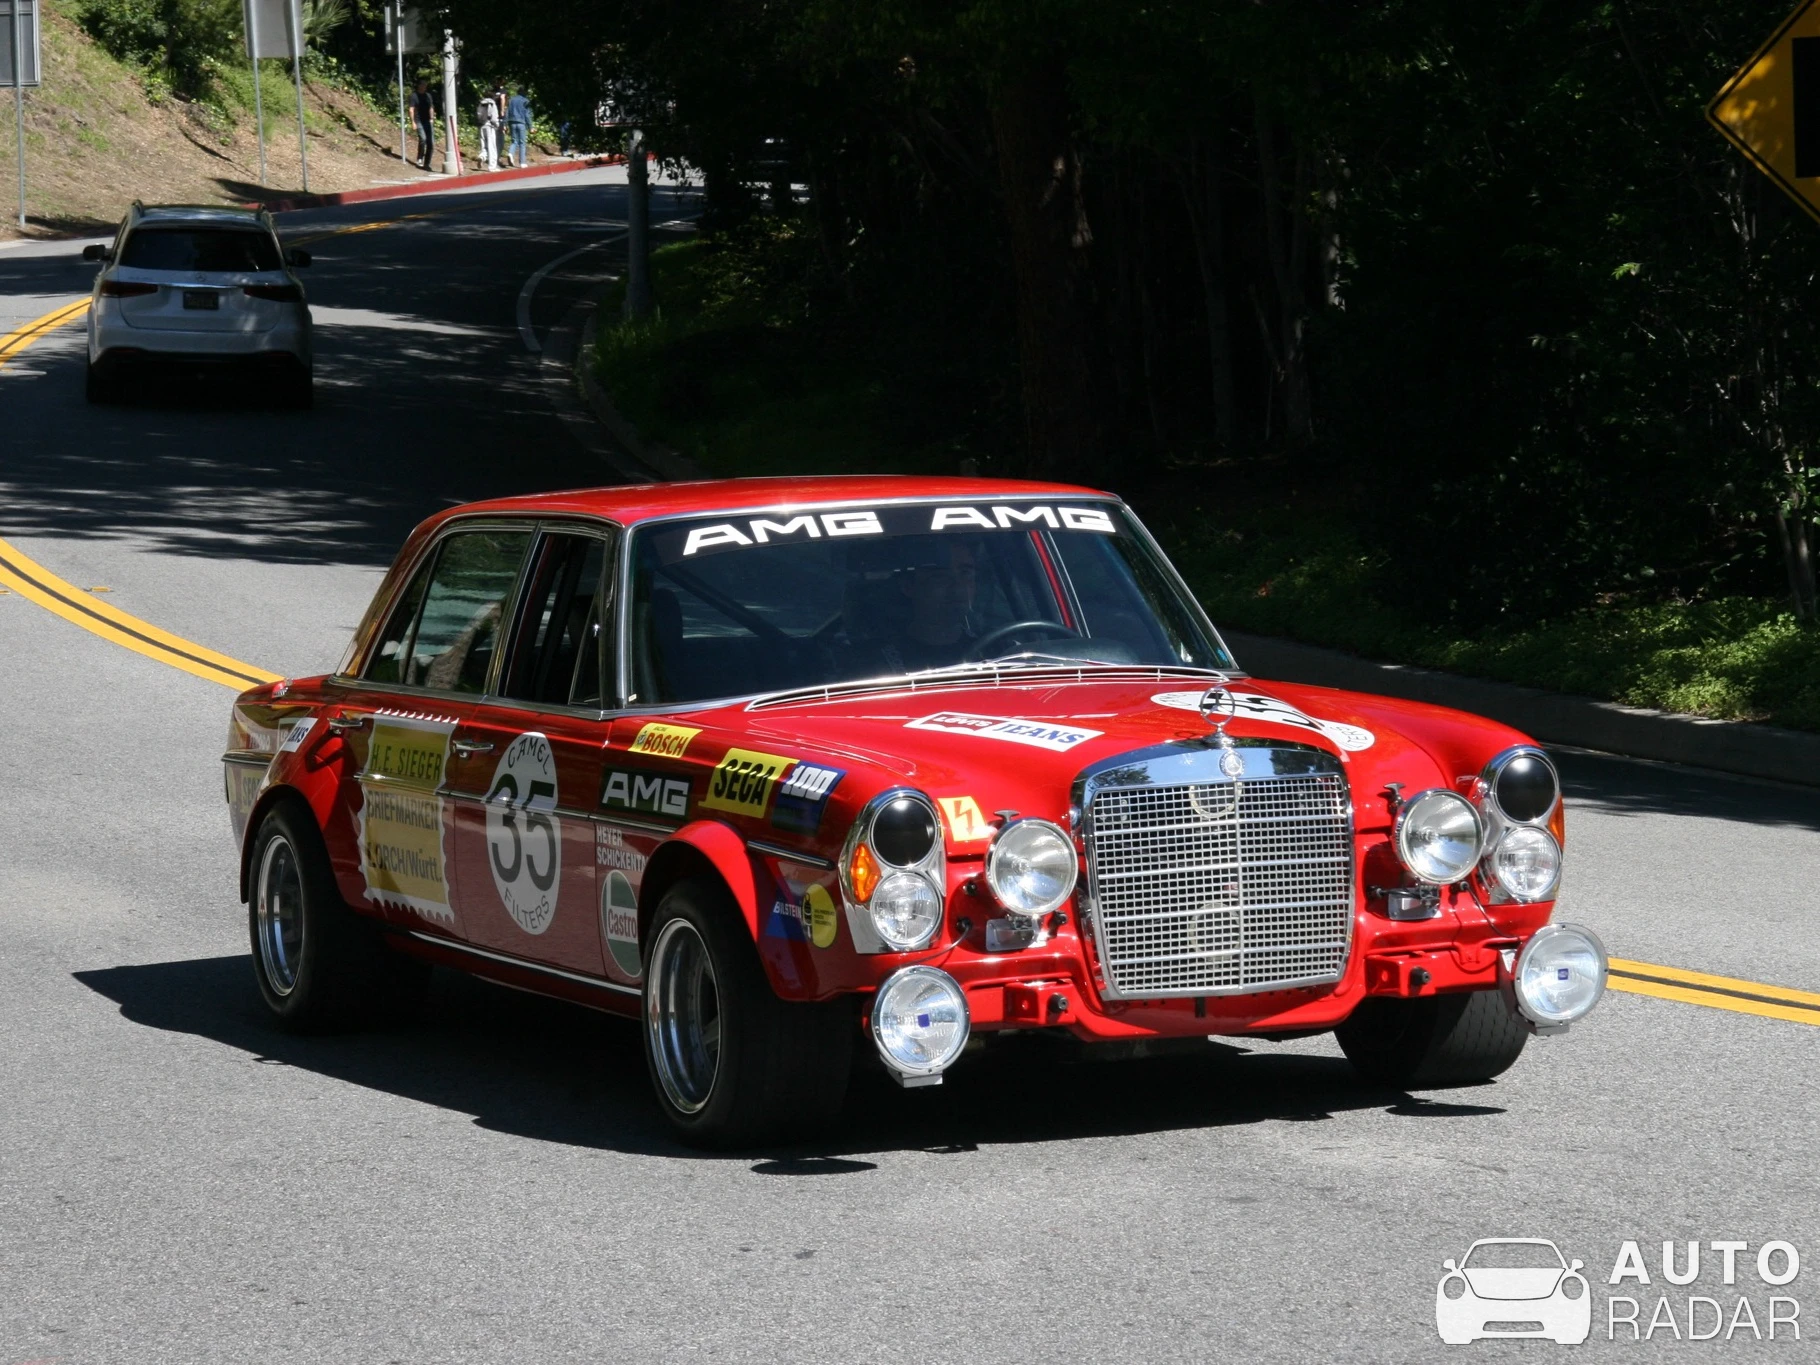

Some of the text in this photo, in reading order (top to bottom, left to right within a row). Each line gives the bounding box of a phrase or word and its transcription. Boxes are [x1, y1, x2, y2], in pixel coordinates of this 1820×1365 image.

[683, 506, 1116, 557] AMG AMG
[640, 732, 689, 757] BOSCH
[993, 723, 1085, 744] JEANS
[398, 747, 443, 781] SIEGER
[507, 736, 550, 775] CAMEL
[602, 772, 689, 816] AMG
[713, 758, 777, 806] SEGA
[780, 765, 838, 801] 100
[366, 790, 440, 832] BRIEFMARKEN
[486, 773, 557, 892] 35
[596, 824, 623, 847] HEYER
[504, 886, 550, 930] FILTERS
[608, 908, 638, 939] Castro
[772, 901, 802, 919] BILSTEIN
